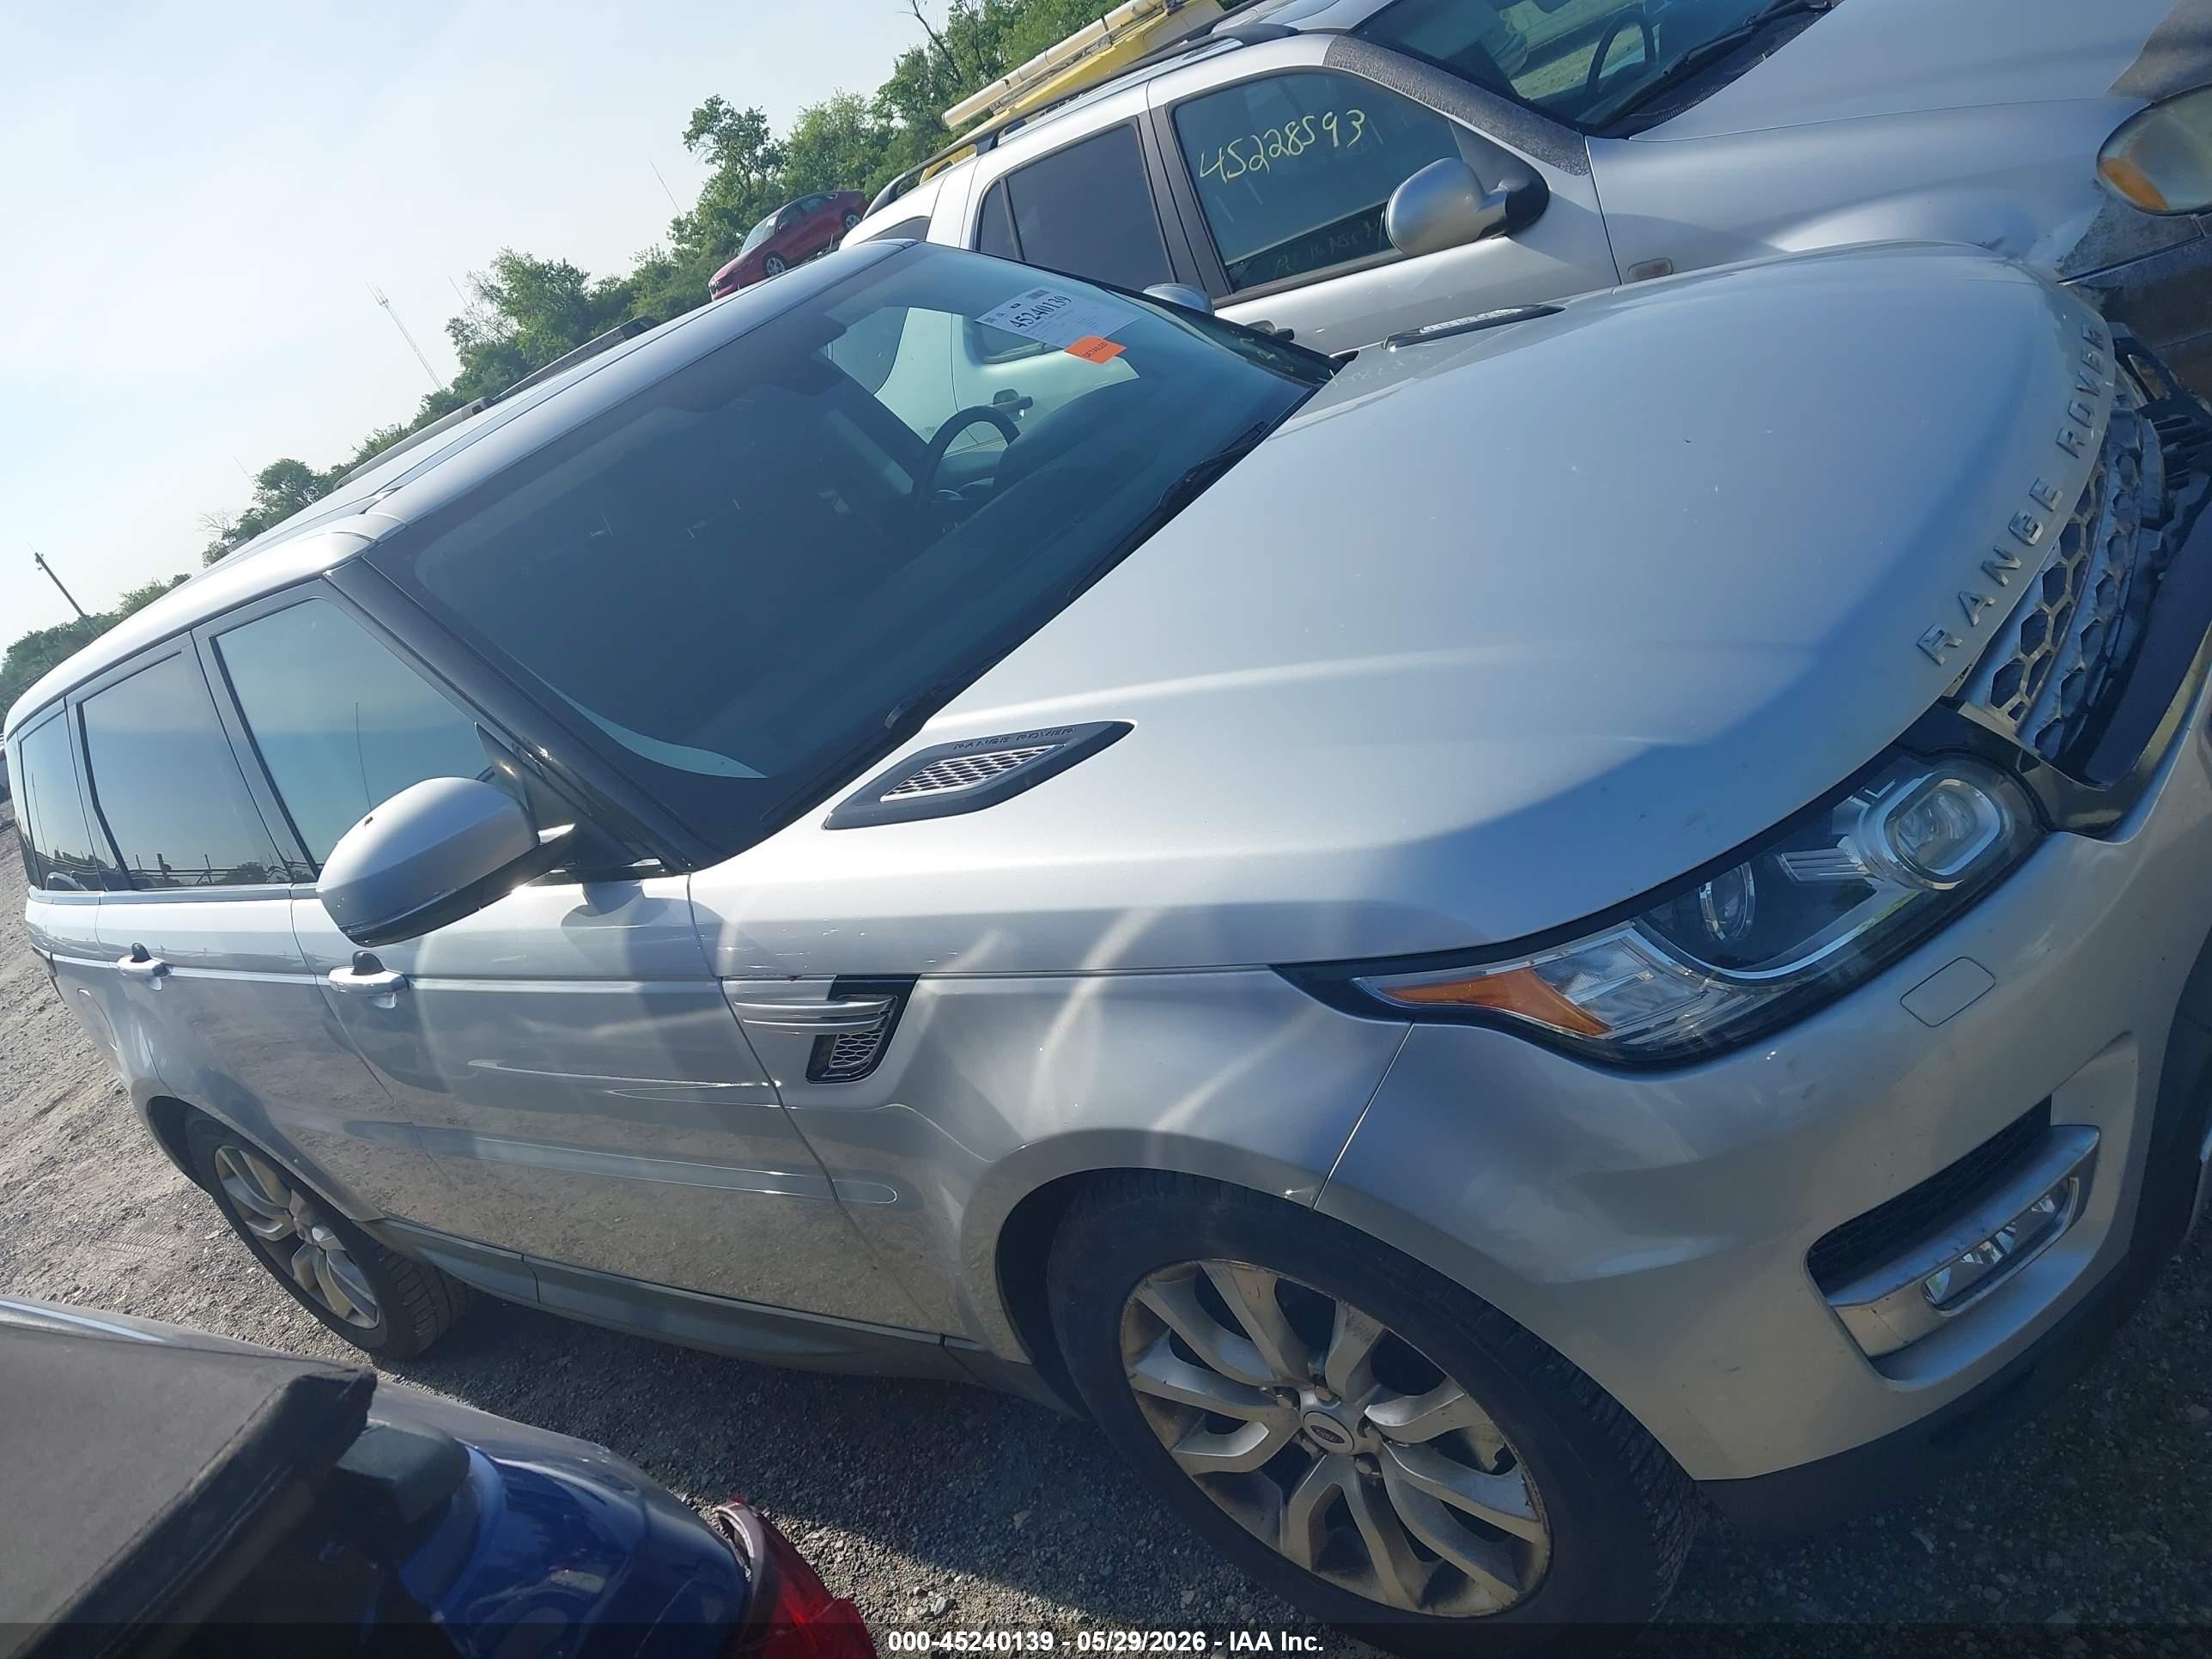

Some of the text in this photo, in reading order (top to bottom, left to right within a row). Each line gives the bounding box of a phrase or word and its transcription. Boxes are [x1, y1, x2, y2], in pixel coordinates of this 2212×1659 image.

[1199, 109, 1365, 184] 45228593
[1009, 295, 1073, 328] 45240139
[1916, 323, 2105, 665] RANGE ROVER
[952, 727, 1074, 750] RANGE ROVER
